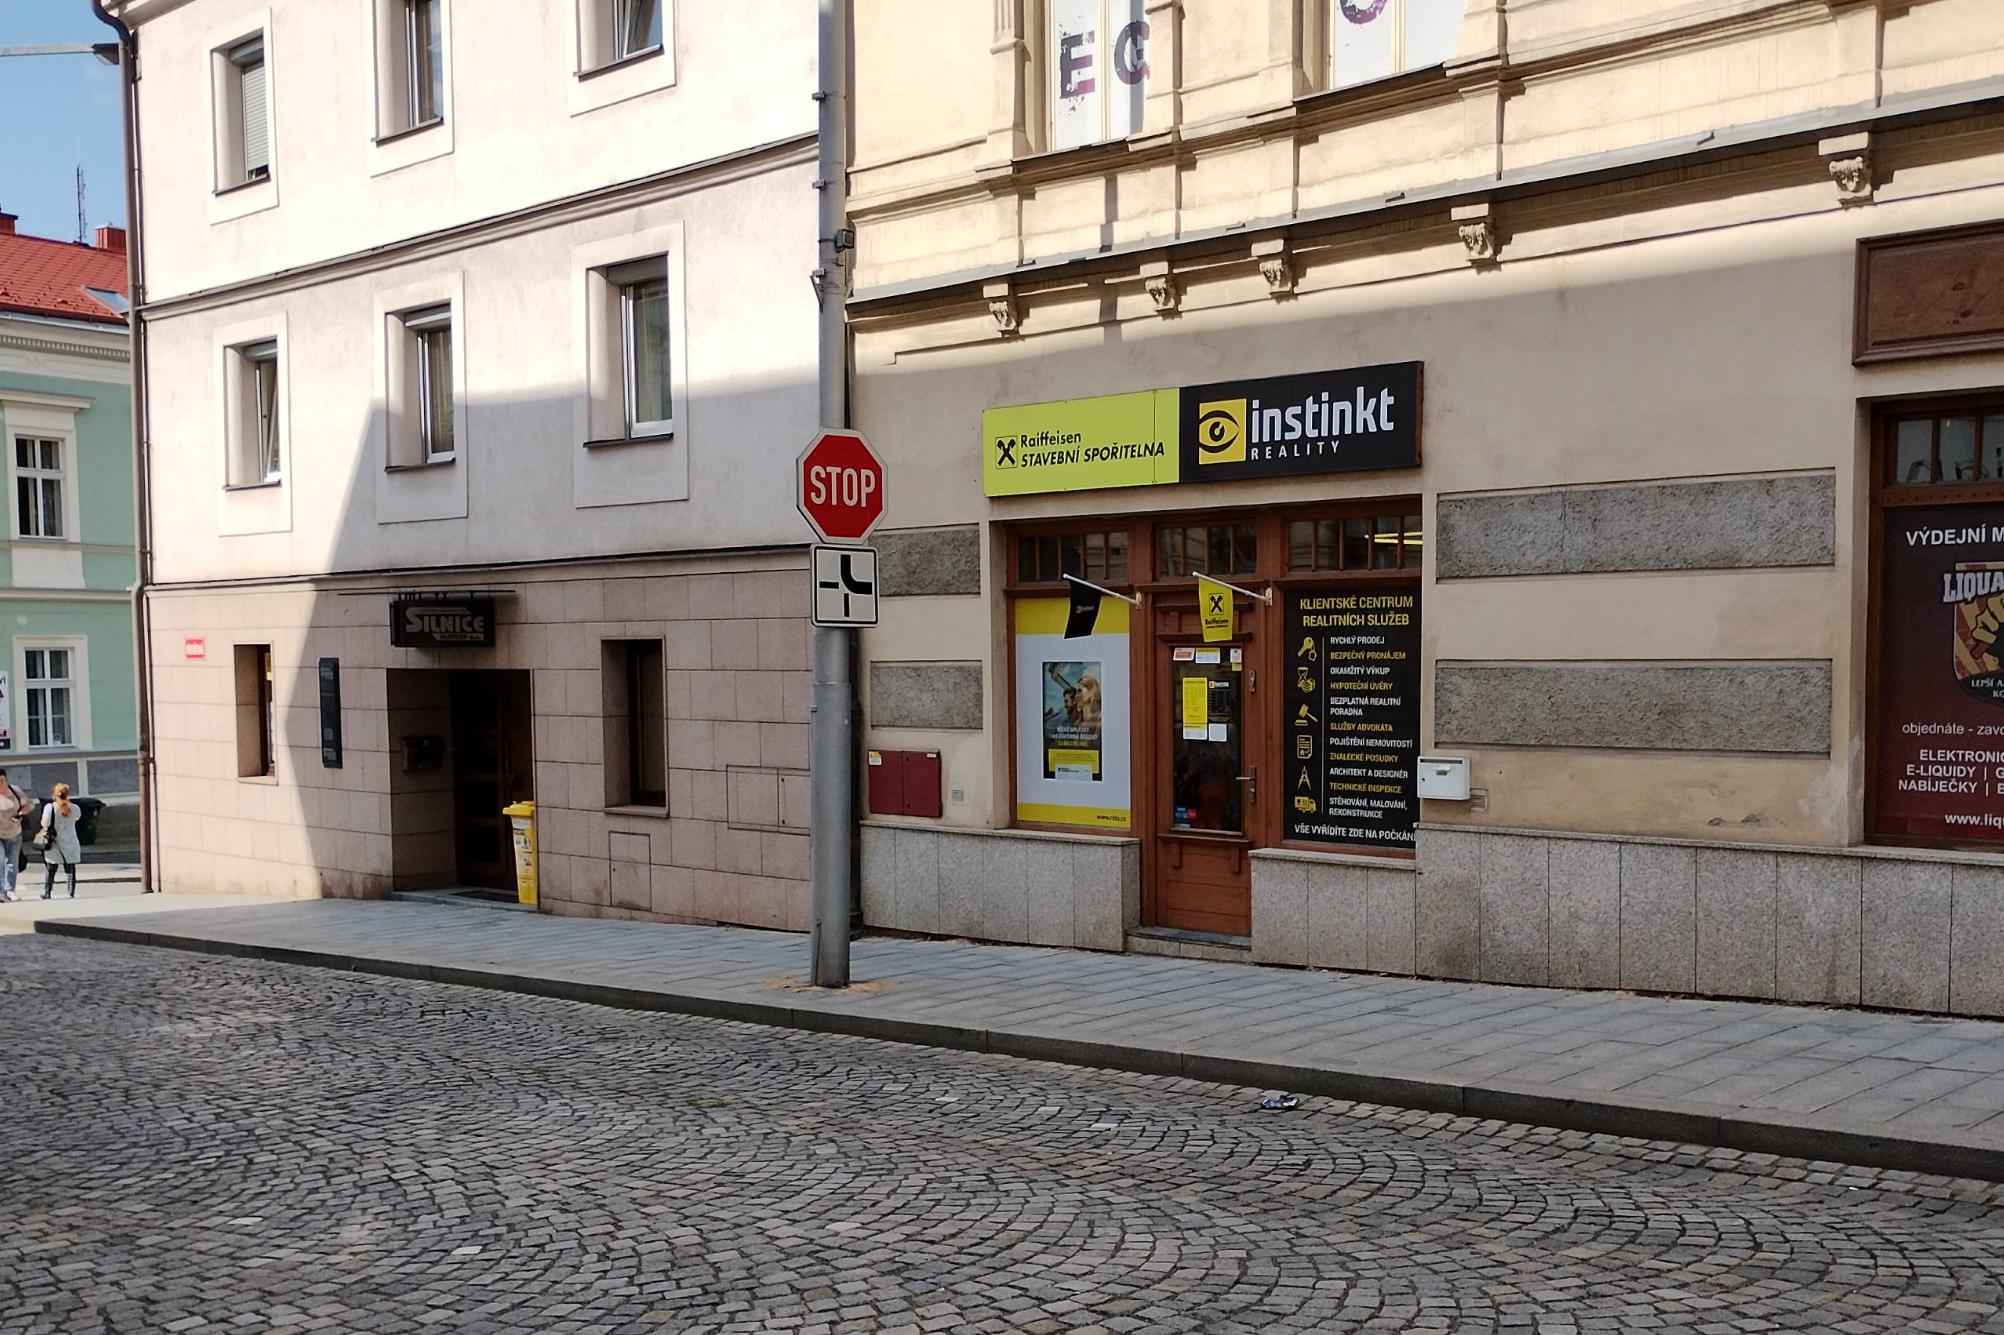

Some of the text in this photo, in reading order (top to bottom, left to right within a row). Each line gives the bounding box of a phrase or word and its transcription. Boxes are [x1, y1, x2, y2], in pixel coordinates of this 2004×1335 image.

[1252, 386, 1394, 443] instinkt
[1021, 431, 1081, 448] Raiffeisen
[1021, 440, 1165, 467] STAVEBNÍ SPOŘITELNA
[1252, 439, 1339, 460] REALITY
[811, 466, 875, 507] STOP
[1905, 524, 1986, 546] VÝDEJNÍ
[1299, 595, 1412, 609] KLIENTSKÉ CENTRUM
[406, 607, 484, 633] SILNICE
[1302, 611, 1409, 626] REALITNÍCH SLUŽEB
[1330, 636, 1384, 645] RYCHLÝ PRODEJ
[1330, 650, 1405, 660] BEZPEČNÝ PRONÁJEM
[1330, 665, 1390, 675] OKAMŽITÝ VÝKUP
[1330, 680, 1368, 690] HYPOTEČNÍ
[1970, 677, 1995, 688] LEPŠÍ
[1330, 696, 1401, 706] BEZPLATNÁ REALITNÍ
[1329, 707, 1363, 717] PORADNA
[1329, 721, 1392, 732] SLUŽBY ADVOKÁTA
[1902, 723, 1964, 736] objednáte
[1329, 736, 1413, 748] POJIŠTĚNÍ NEMOVITOSTÍ
[1329, 753, 1398, 763] ZNALECKÉ POSUDKY
[1329, 768, 1366, 777] ARCHITEKT
[1374, 769, 1408, 779] DESIGNÉR
[1906, 763, 1976, 777] E-LIQUIDY
[1329, 782, 1401, 794] TECHNICKÉ INSPEKCE
[1898, 778, 1977, 793] NABÍJEČKY
[1329, 796, 1408, 810] STĚHOVÁNÍ, MALOVÁNÍ,
[1328, 808, 1382, 818] REKONSTRUKCE
[1944, 814, 2004, 829] www.liq
[1294, 823, 1310, 833] VŠE
[1311, 824, 1346, 836] VYŘÍDÍTE
[1349, 828, 1363, 838] ZDE
[1366, 829, 1377, 839] NA
